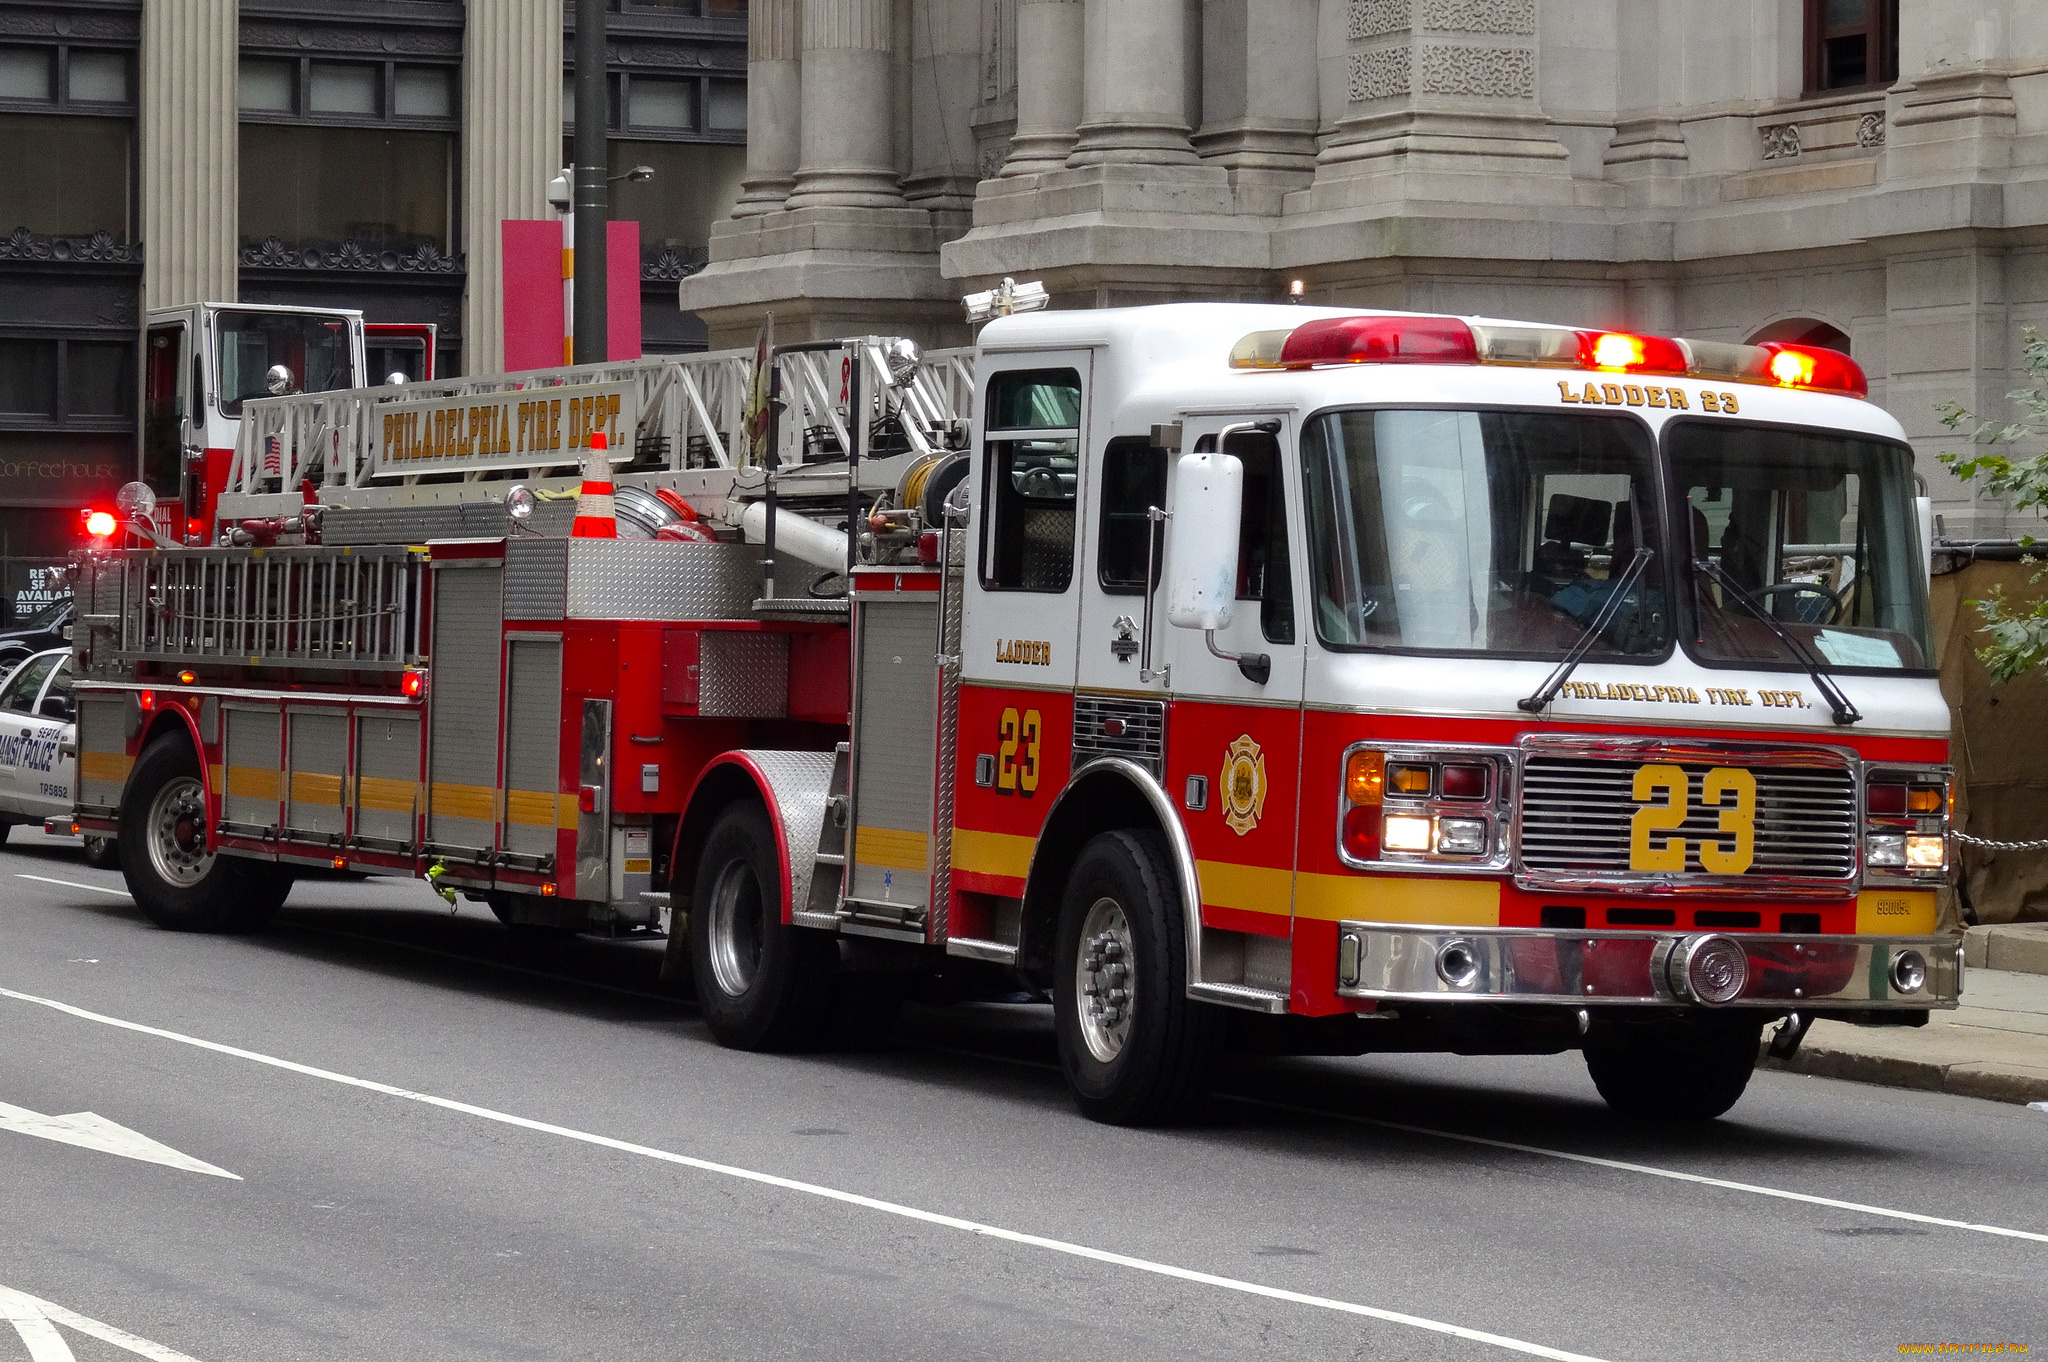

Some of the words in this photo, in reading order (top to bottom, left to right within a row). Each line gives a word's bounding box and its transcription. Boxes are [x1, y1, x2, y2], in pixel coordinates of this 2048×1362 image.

[1558, 381, 1690, 410] LADDER
[1701, 390, 1740, 414] 23
[383, 405, 511, 463] PHILADELPHIA
[518, 400, 562, 454] FIRE
[569, 394, 625, 449] DEPT.
[16, 604, 33, 613] 215
[996, 639, 1051, 665] LADDER
[1562, 681, 1701, 704] PHILADELPHIA
[1706, 687, 1753, 705] FIRE
[1758, 689, 1813, 709] DEPT.
[37, 727, 61, 740] SEPTA
[22, 738, 57, 772] POLICE
[997, 707, 1042, 796] 23
[40, 783, 68, 798] TP5852
[1629, 764, 1757, 874] 23
